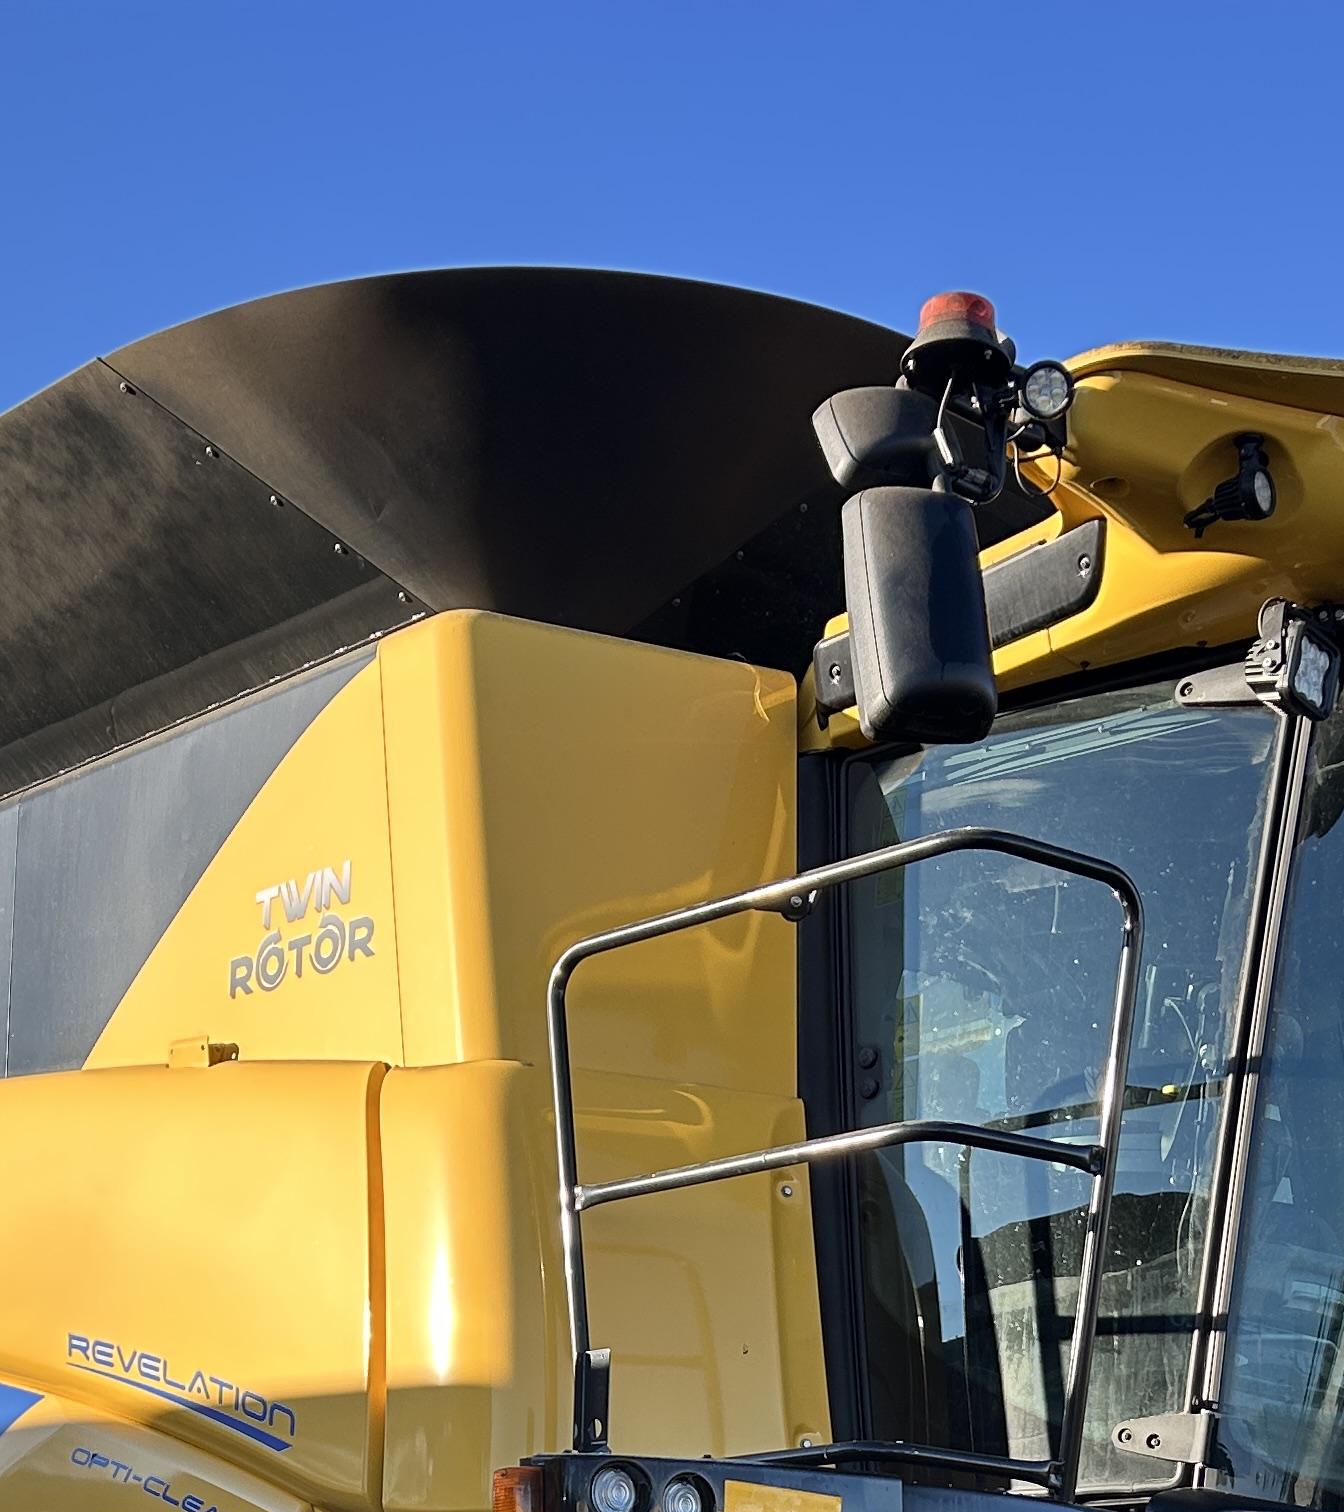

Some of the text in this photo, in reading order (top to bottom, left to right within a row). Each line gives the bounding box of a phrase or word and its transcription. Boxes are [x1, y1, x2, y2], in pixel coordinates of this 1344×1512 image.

[256, 860, 352, 929] TWIN
[230, 912, 375, 999] ROTOR
[67, 1332, 296, 1436] REVELATION
